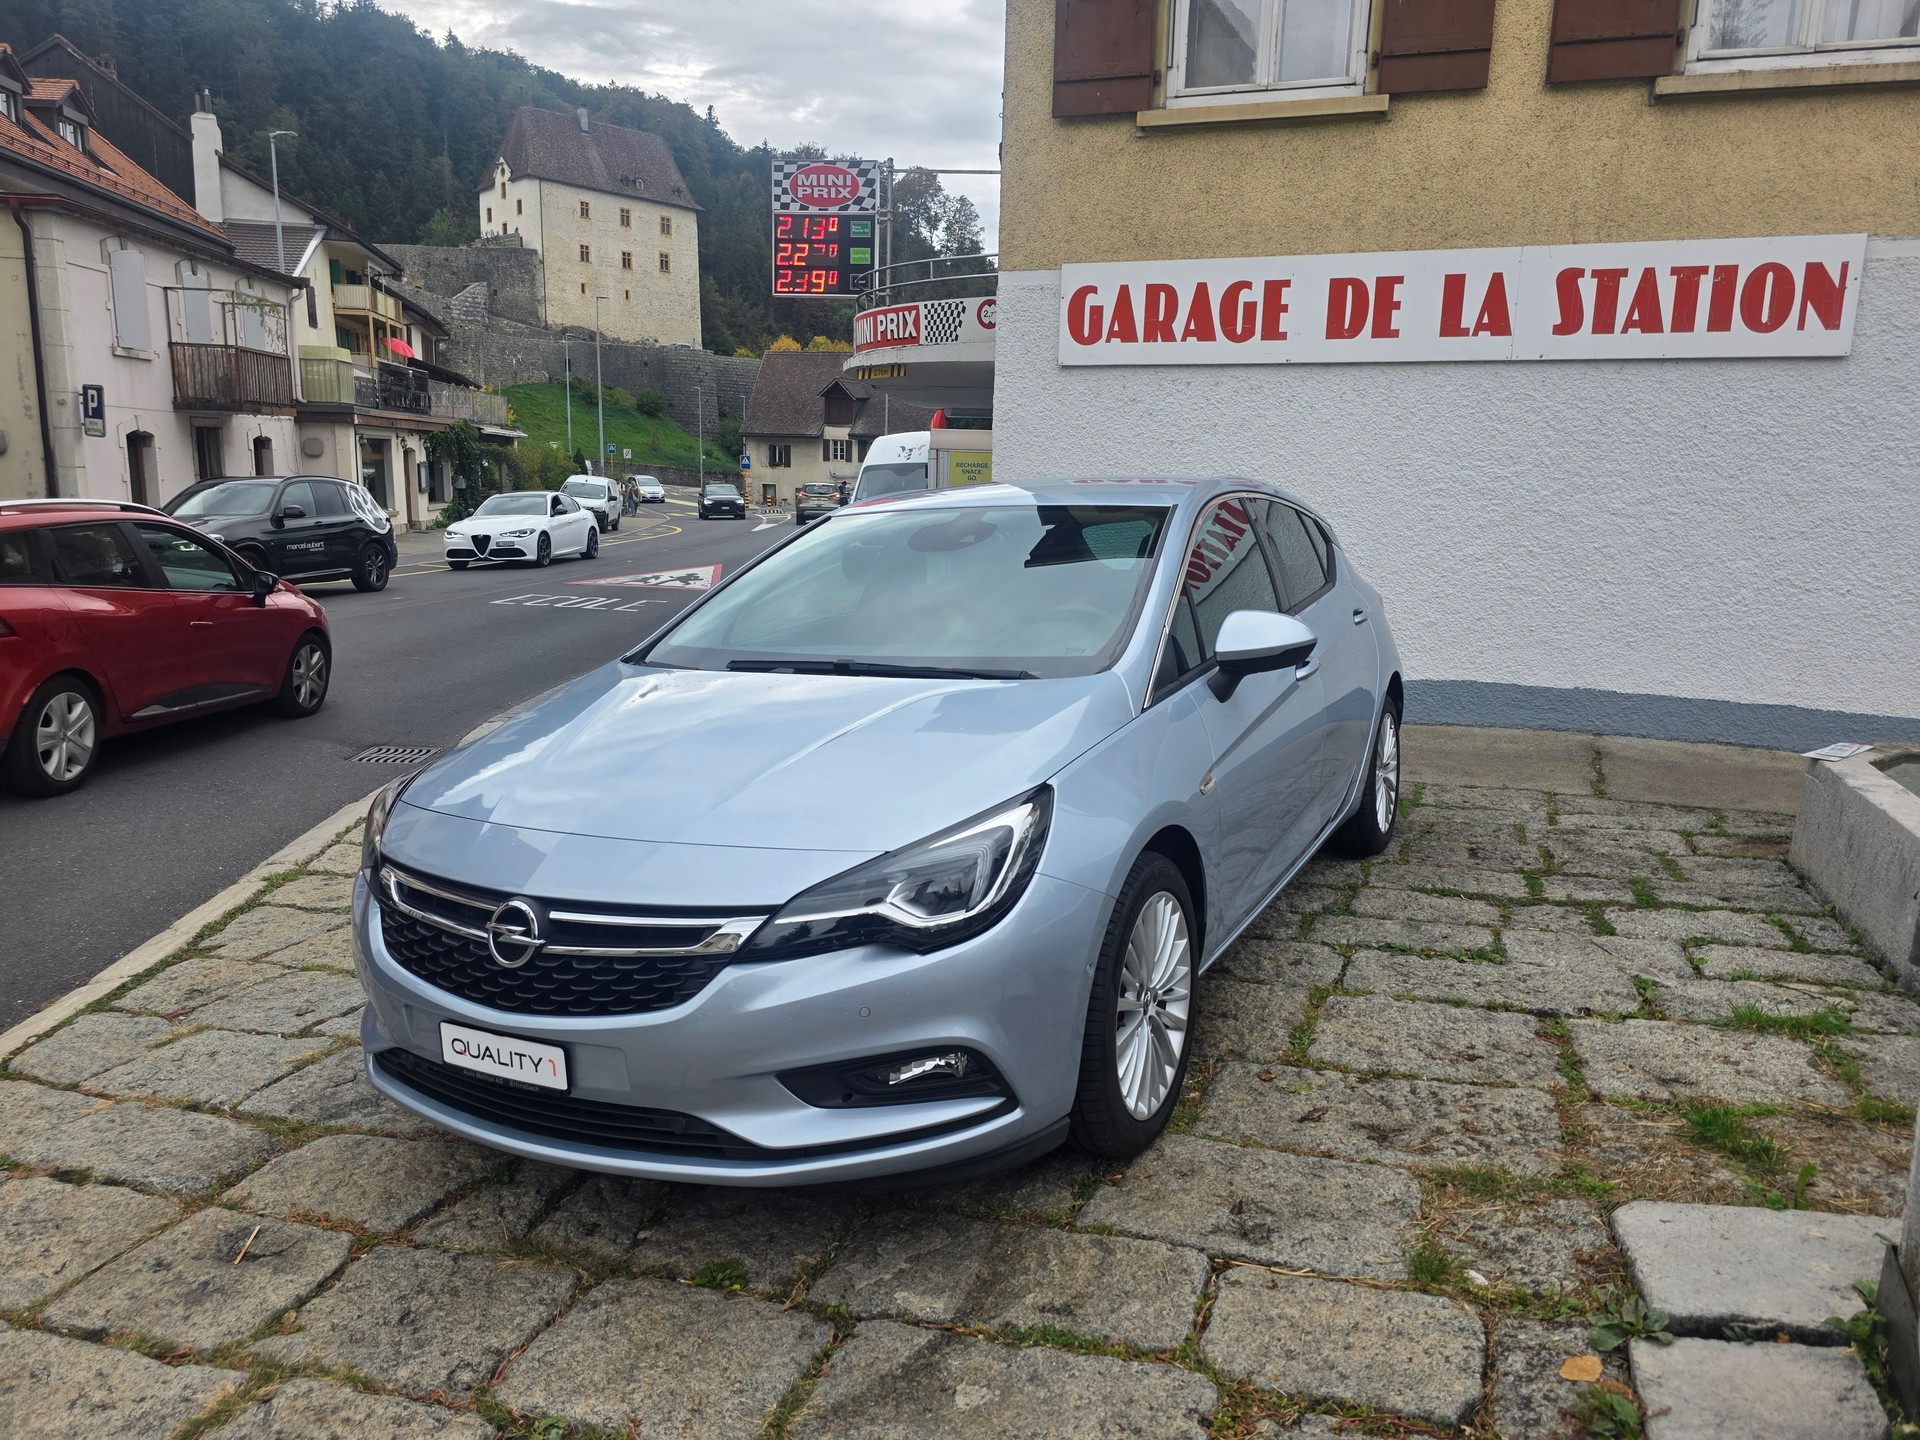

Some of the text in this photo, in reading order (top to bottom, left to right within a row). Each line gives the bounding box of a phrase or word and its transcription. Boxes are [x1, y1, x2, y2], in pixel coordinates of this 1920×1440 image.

[797, 174, 851, 186] MINI
[797, 187, 852, 199] PRIX
[1067, 260, 1850, 346] GARAGE DE LA STATION
[856, 310, 918, 346] MINI PRIX
[88, 389, 98, 416] P
[306, 541, 325, 549] aubert
[488, 593, 668, 612] ECOLE
[451, 1037, 543, 1073] QUALITY
